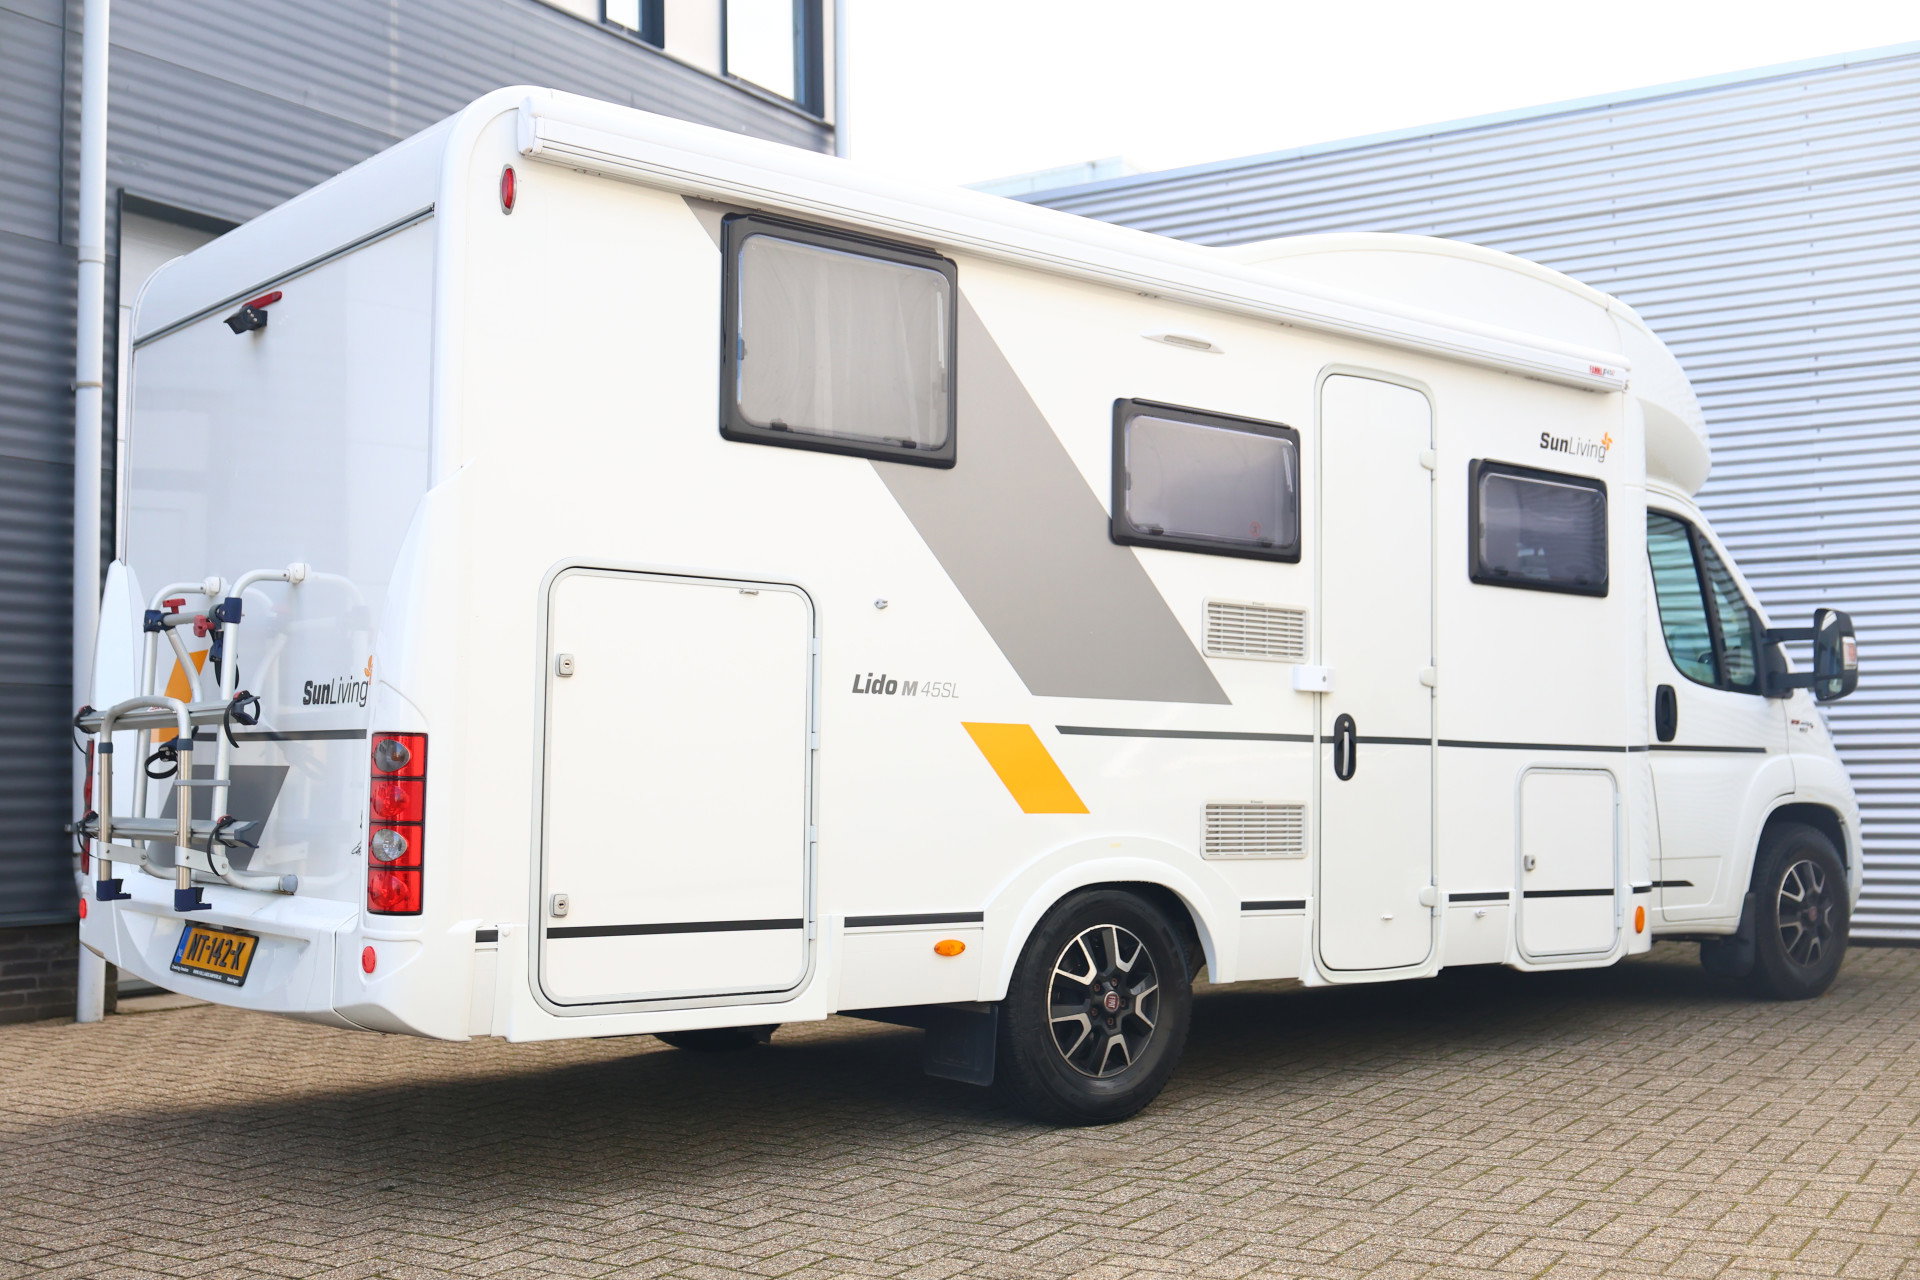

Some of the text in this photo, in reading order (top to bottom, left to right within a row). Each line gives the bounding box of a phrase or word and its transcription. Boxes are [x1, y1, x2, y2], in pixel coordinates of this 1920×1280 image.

[1540, 432, 1606, 463] SunLiving
[302, 675, 369, 707] SunLiving
[852, 672, 960, 698] Lido M 45SL
[186, 933, 246, 970] NT-142-X
